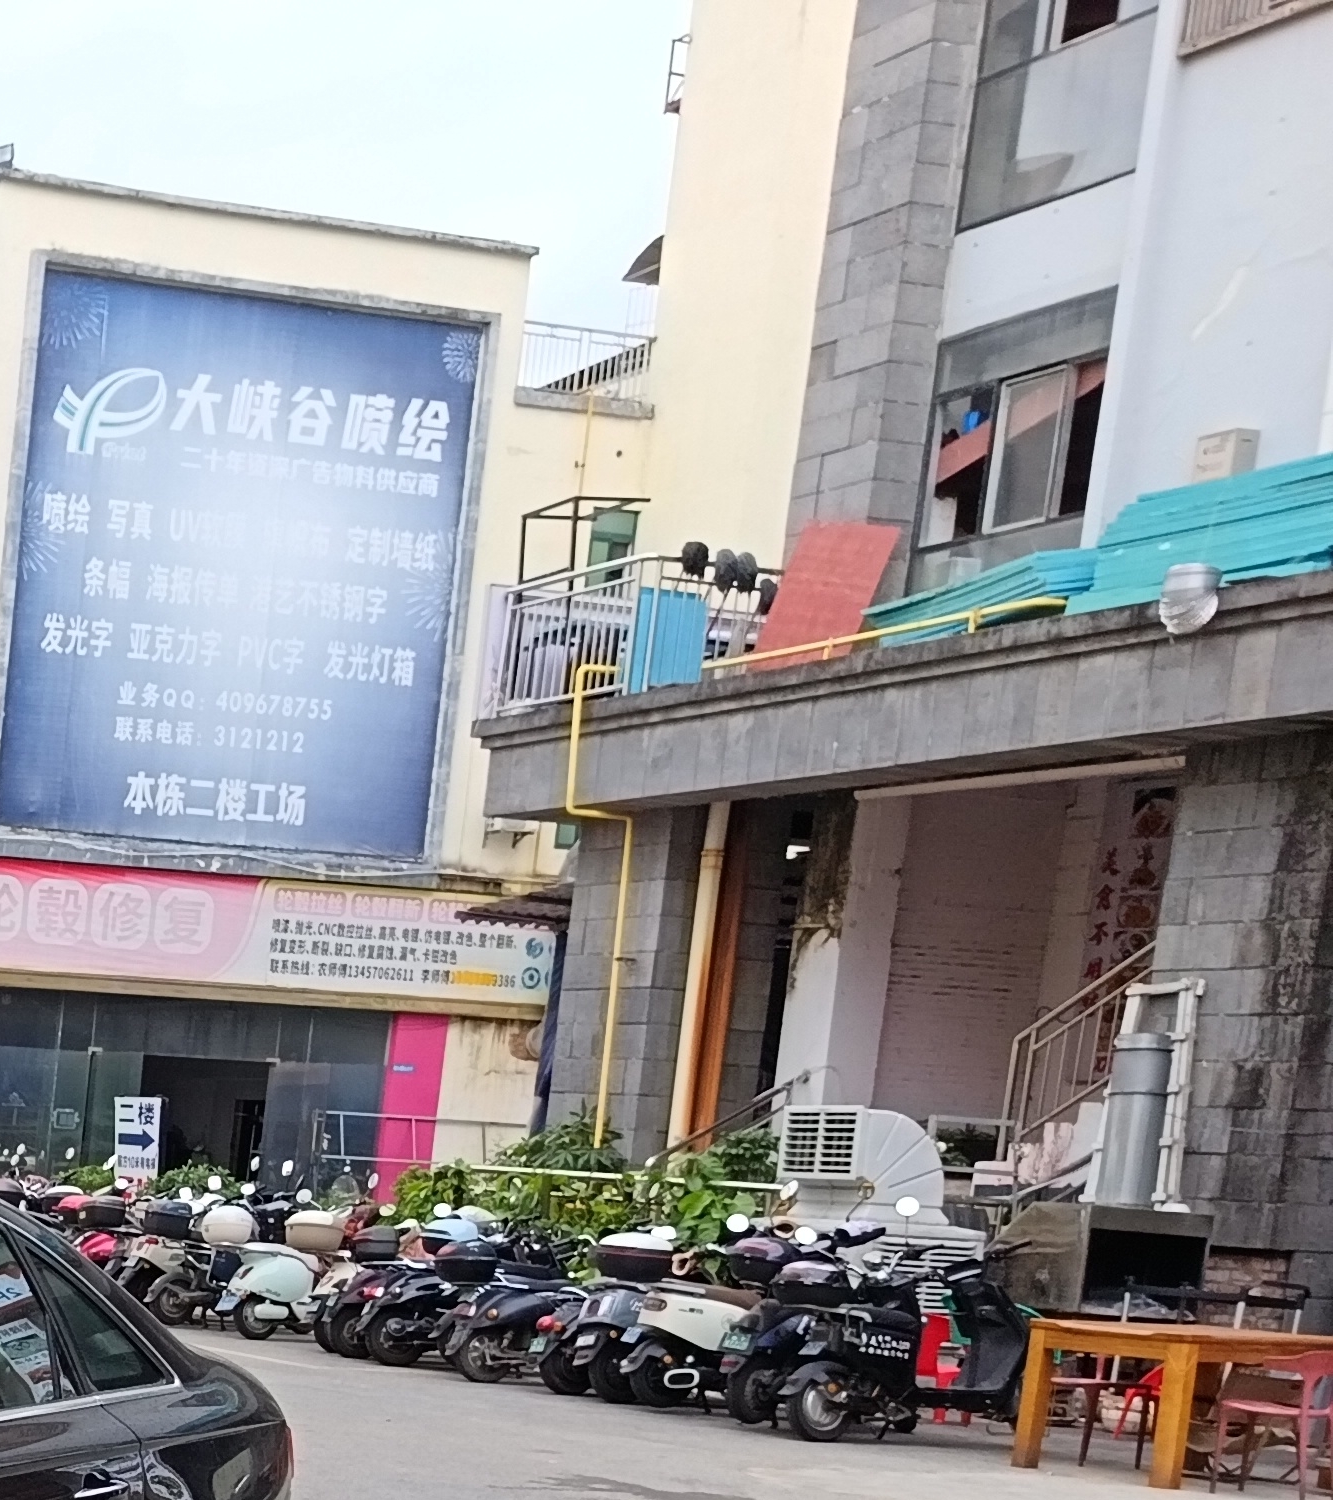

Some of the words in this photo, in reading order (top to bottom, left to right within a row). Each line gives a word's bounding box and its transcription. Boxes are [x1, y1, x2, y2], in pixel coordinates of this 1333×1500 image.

[169, 372, 450, 464] 大峡谷喷绘
[42, 493, 91, 535] 喷绘
[108, 499, 154, 541] 写真
[345, 526, 437, 573] 定制墙纸
[83, 556, 132, 601] 条幅
[40, 612, 113, 659] 发光字
[126, 622, 222, 669] 亚克力字
[237, 635, 304, 676] PVC字
[322, 640, 416, 688] 发光灯箱
[123, 770, 307, 826] 本栋二楼工场
[118, 1101, 155, 1125] 二楼
